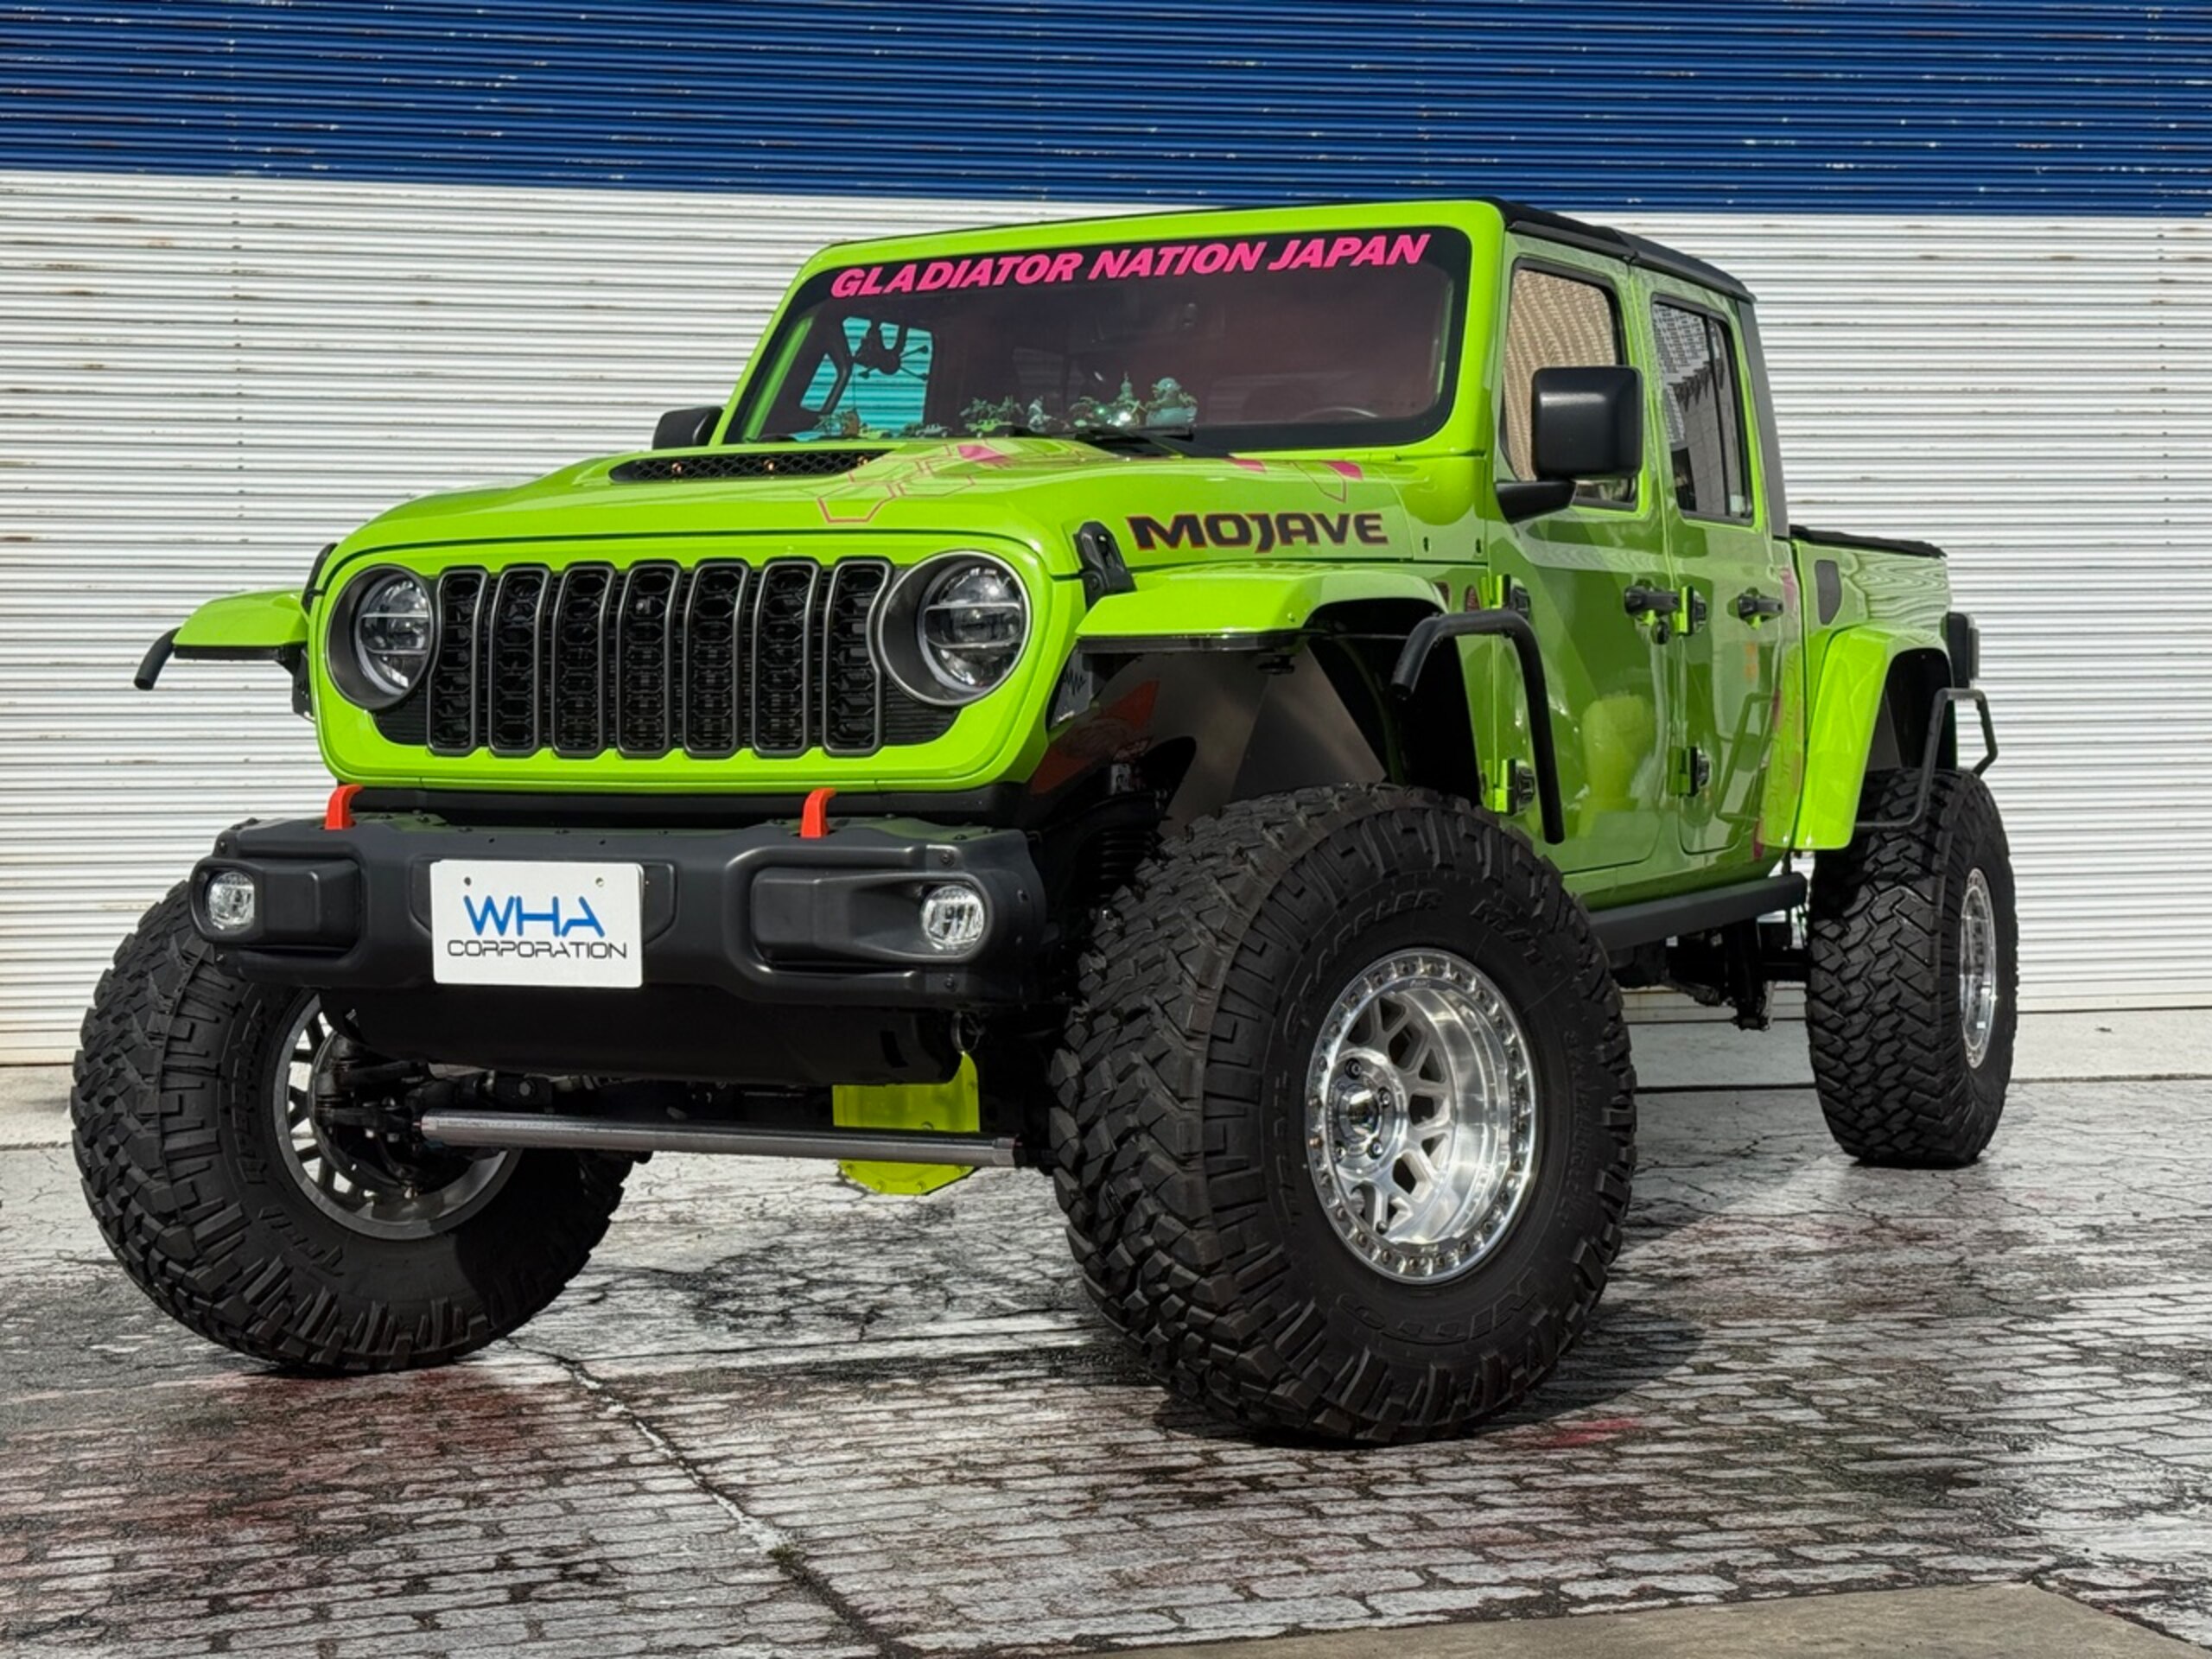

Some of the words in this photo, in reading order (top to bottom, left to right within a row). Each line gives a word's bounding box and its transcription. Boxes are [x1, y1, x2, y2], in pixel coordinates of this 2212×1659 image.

[830, 251, 1084, 298] GLADIATOR
[1088, 241, 1266, 280] NATION
[1268, 233, 1430, 271] JAPAN
[1126, 512, 1389, 554] MOJAVE
[463, 894, 606, 938] WHA
[447, 939, 627, 960] CORPORATION
